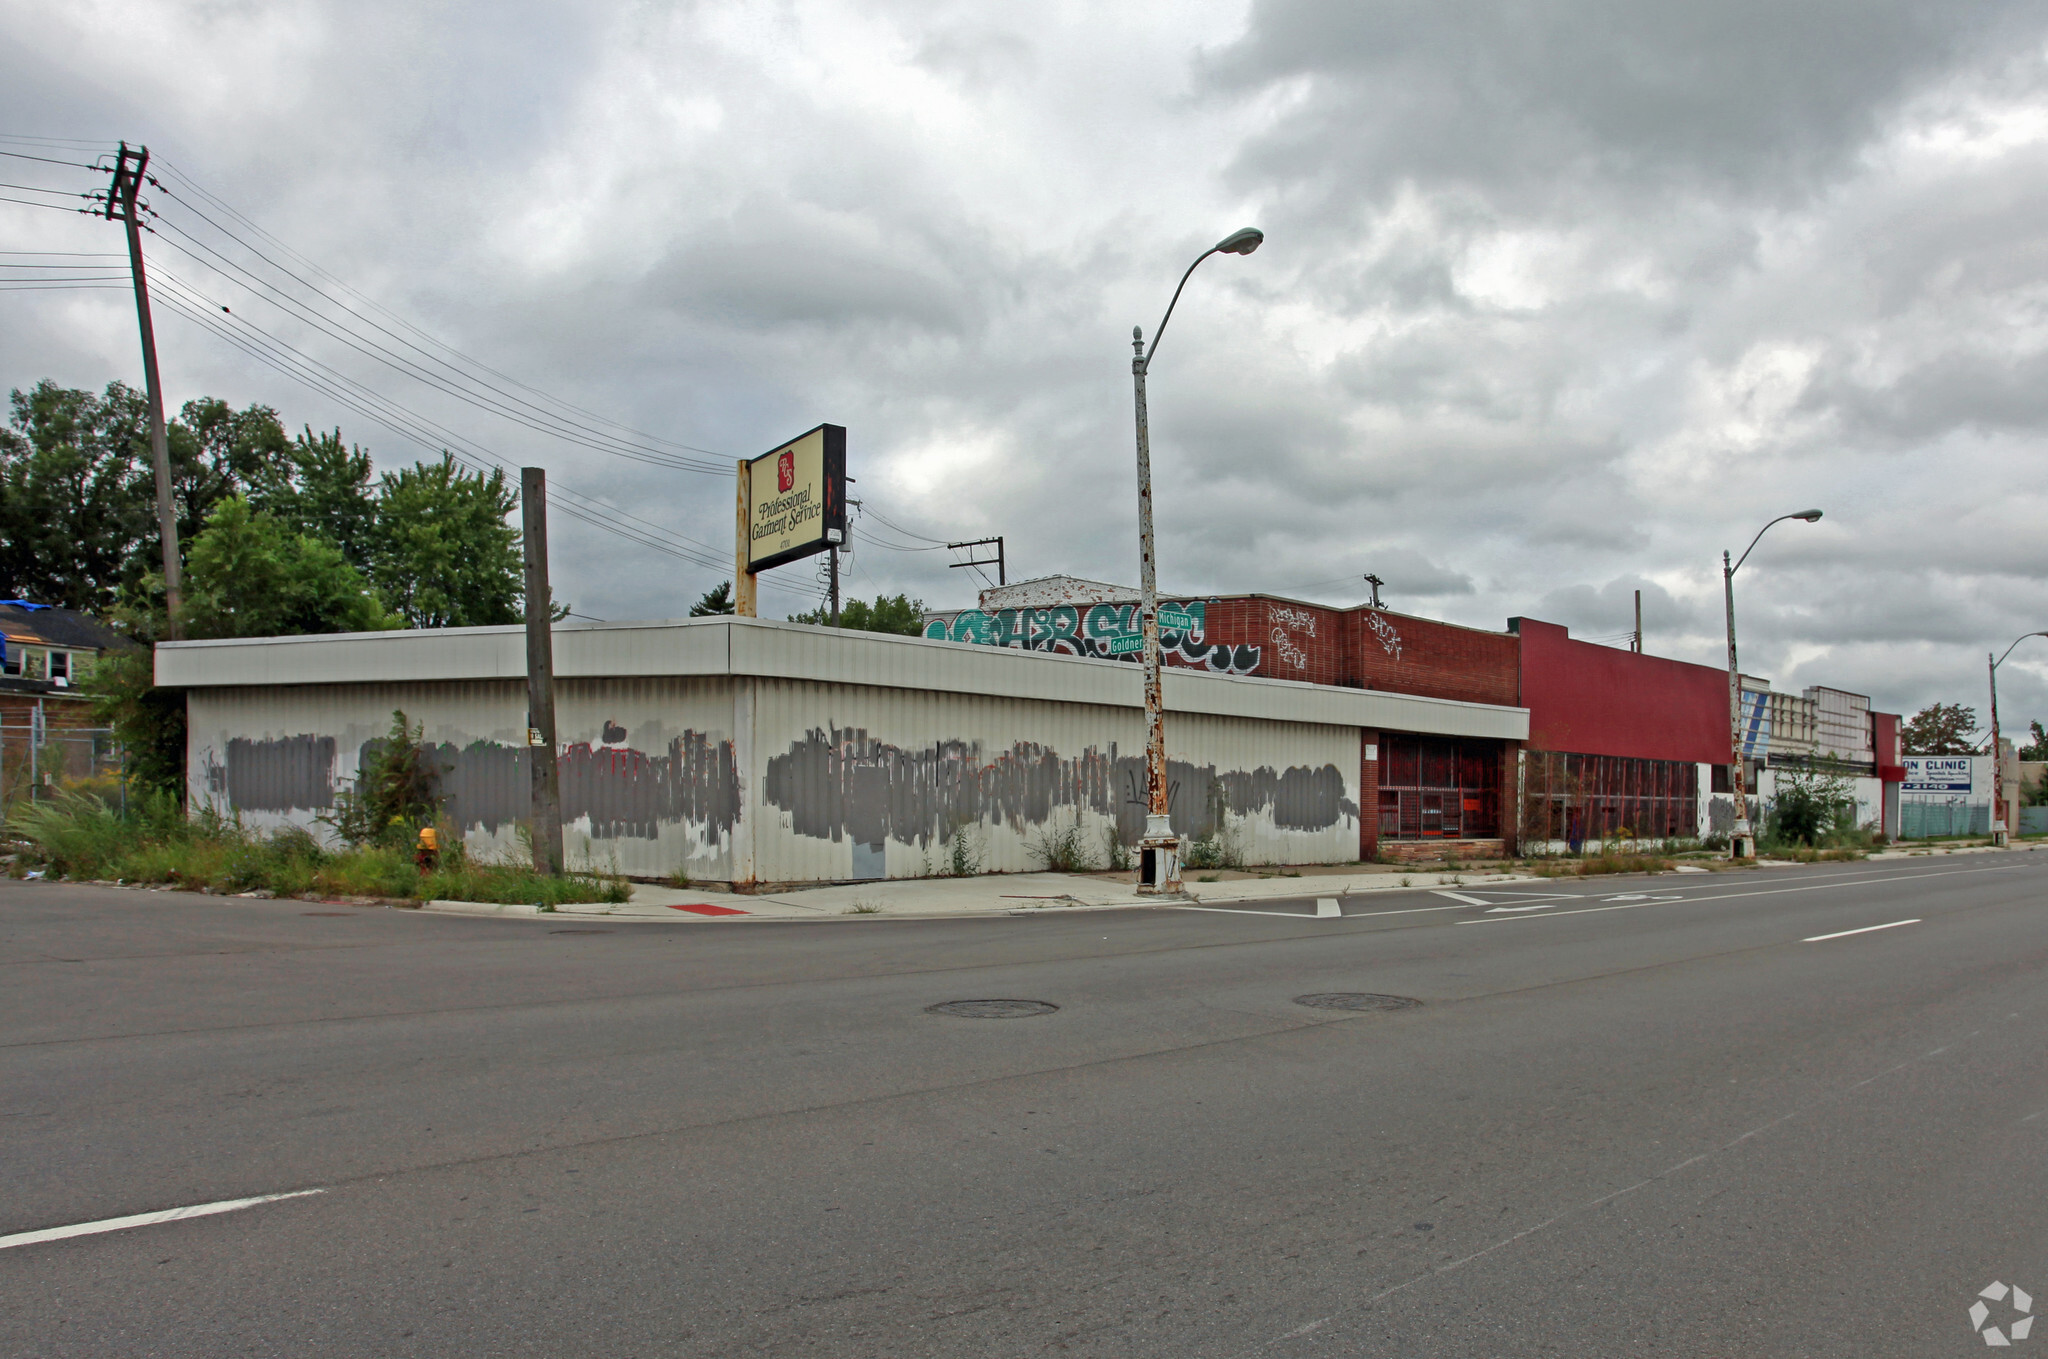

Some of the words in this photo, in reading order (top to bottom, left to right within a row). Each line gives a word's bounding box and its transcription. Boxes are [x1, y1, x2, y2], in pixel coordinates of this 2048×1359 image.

[759, 482, 811, 520] Professional
[752, 514, 787, 541] Garment
[788, 501, 821, 531] Service
[1159, 613, 1189, 628] Michigan
[1112, 639, 1143, 652] Goldner
[1926, 761, 1966, 769] CLINIC
